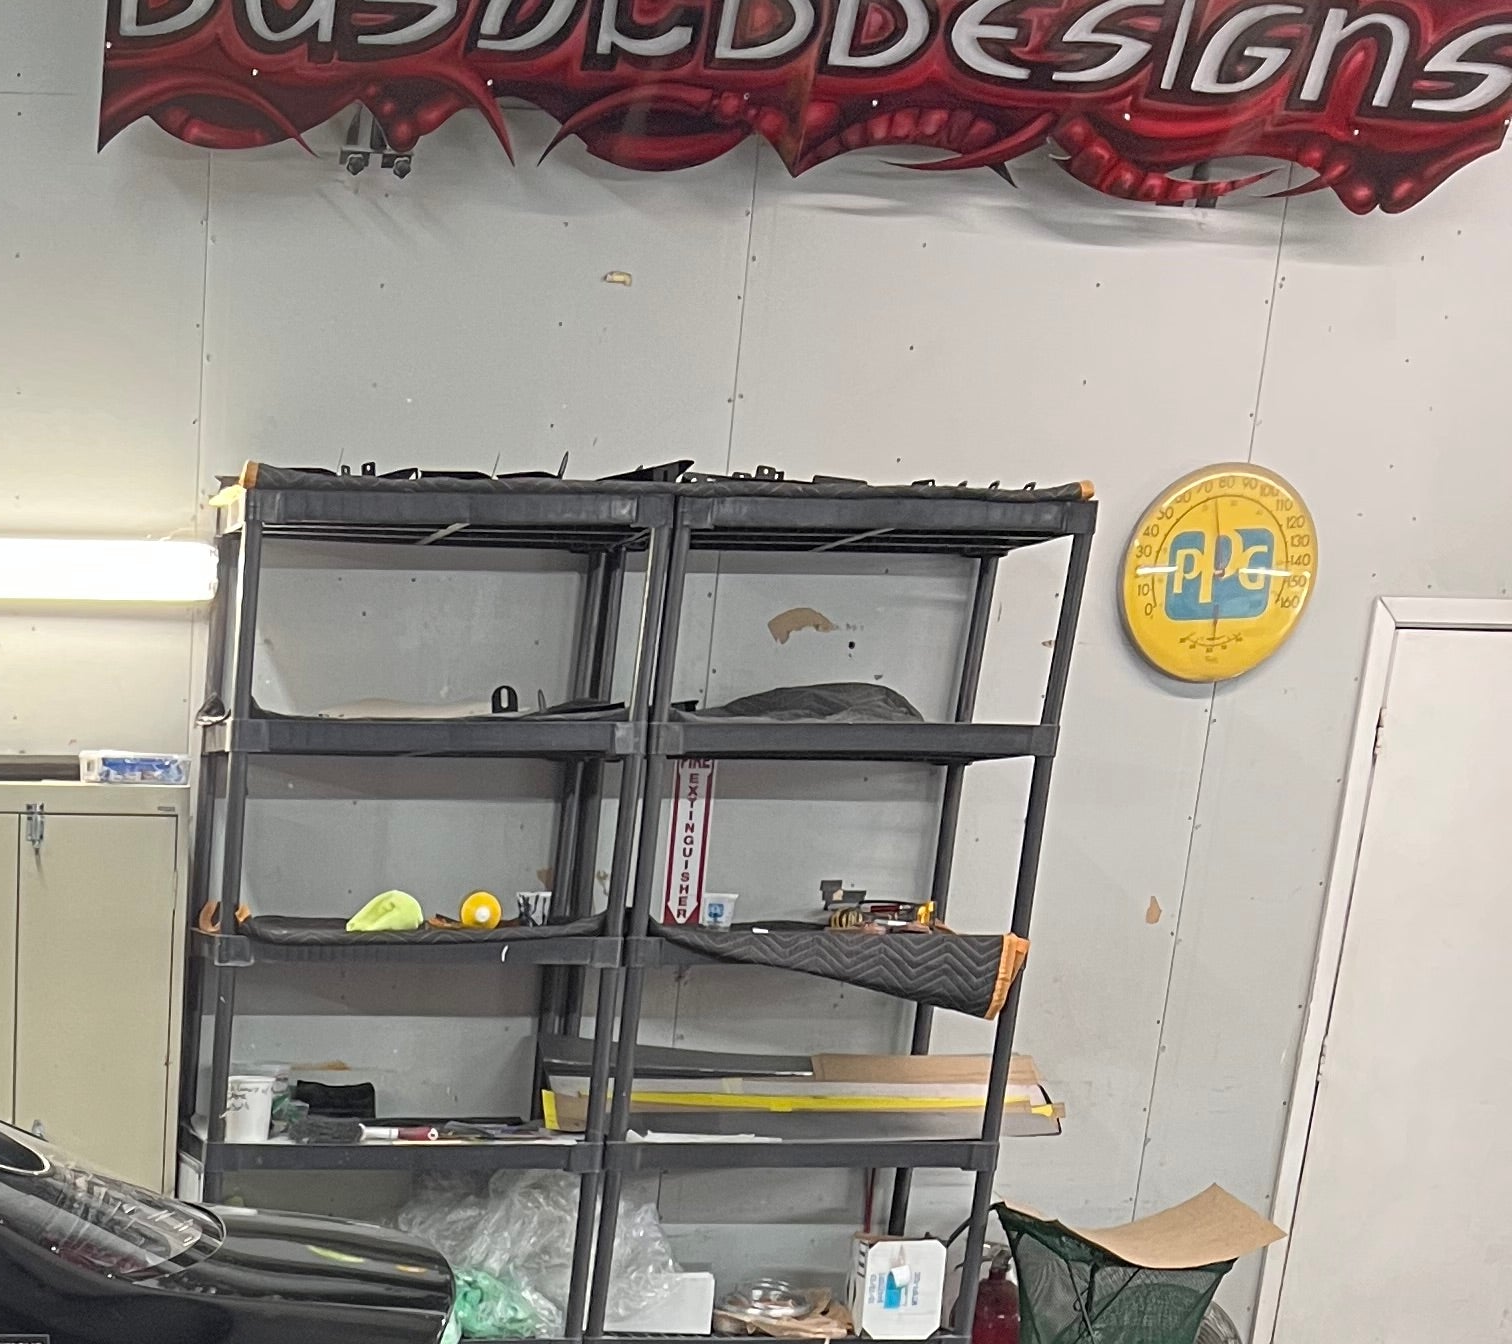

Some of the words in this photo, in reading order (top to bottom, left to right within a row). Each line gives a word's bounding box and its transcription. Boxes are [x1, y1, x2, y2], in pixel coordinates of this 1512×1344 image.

[1242, 477, 1258, 490] 90
[1260, 484, 1280, 497] 100
[1276, 499, 1294, 512] 110
[1286, 515, 1306, 529] 120
[1142, 524, 1160, 538] 40
[1290, 534, 1310, 547] 130
[1135, 544, 1153, 558] 30
[1290, 553, 1311, 566] 140
[1137, 584, 1150, 597] 10
[1280, 595, 1300, 608] 160
[1144, 602, 1154, 616] 0
[676, 773, 700, 919] EXTINGUISHER
